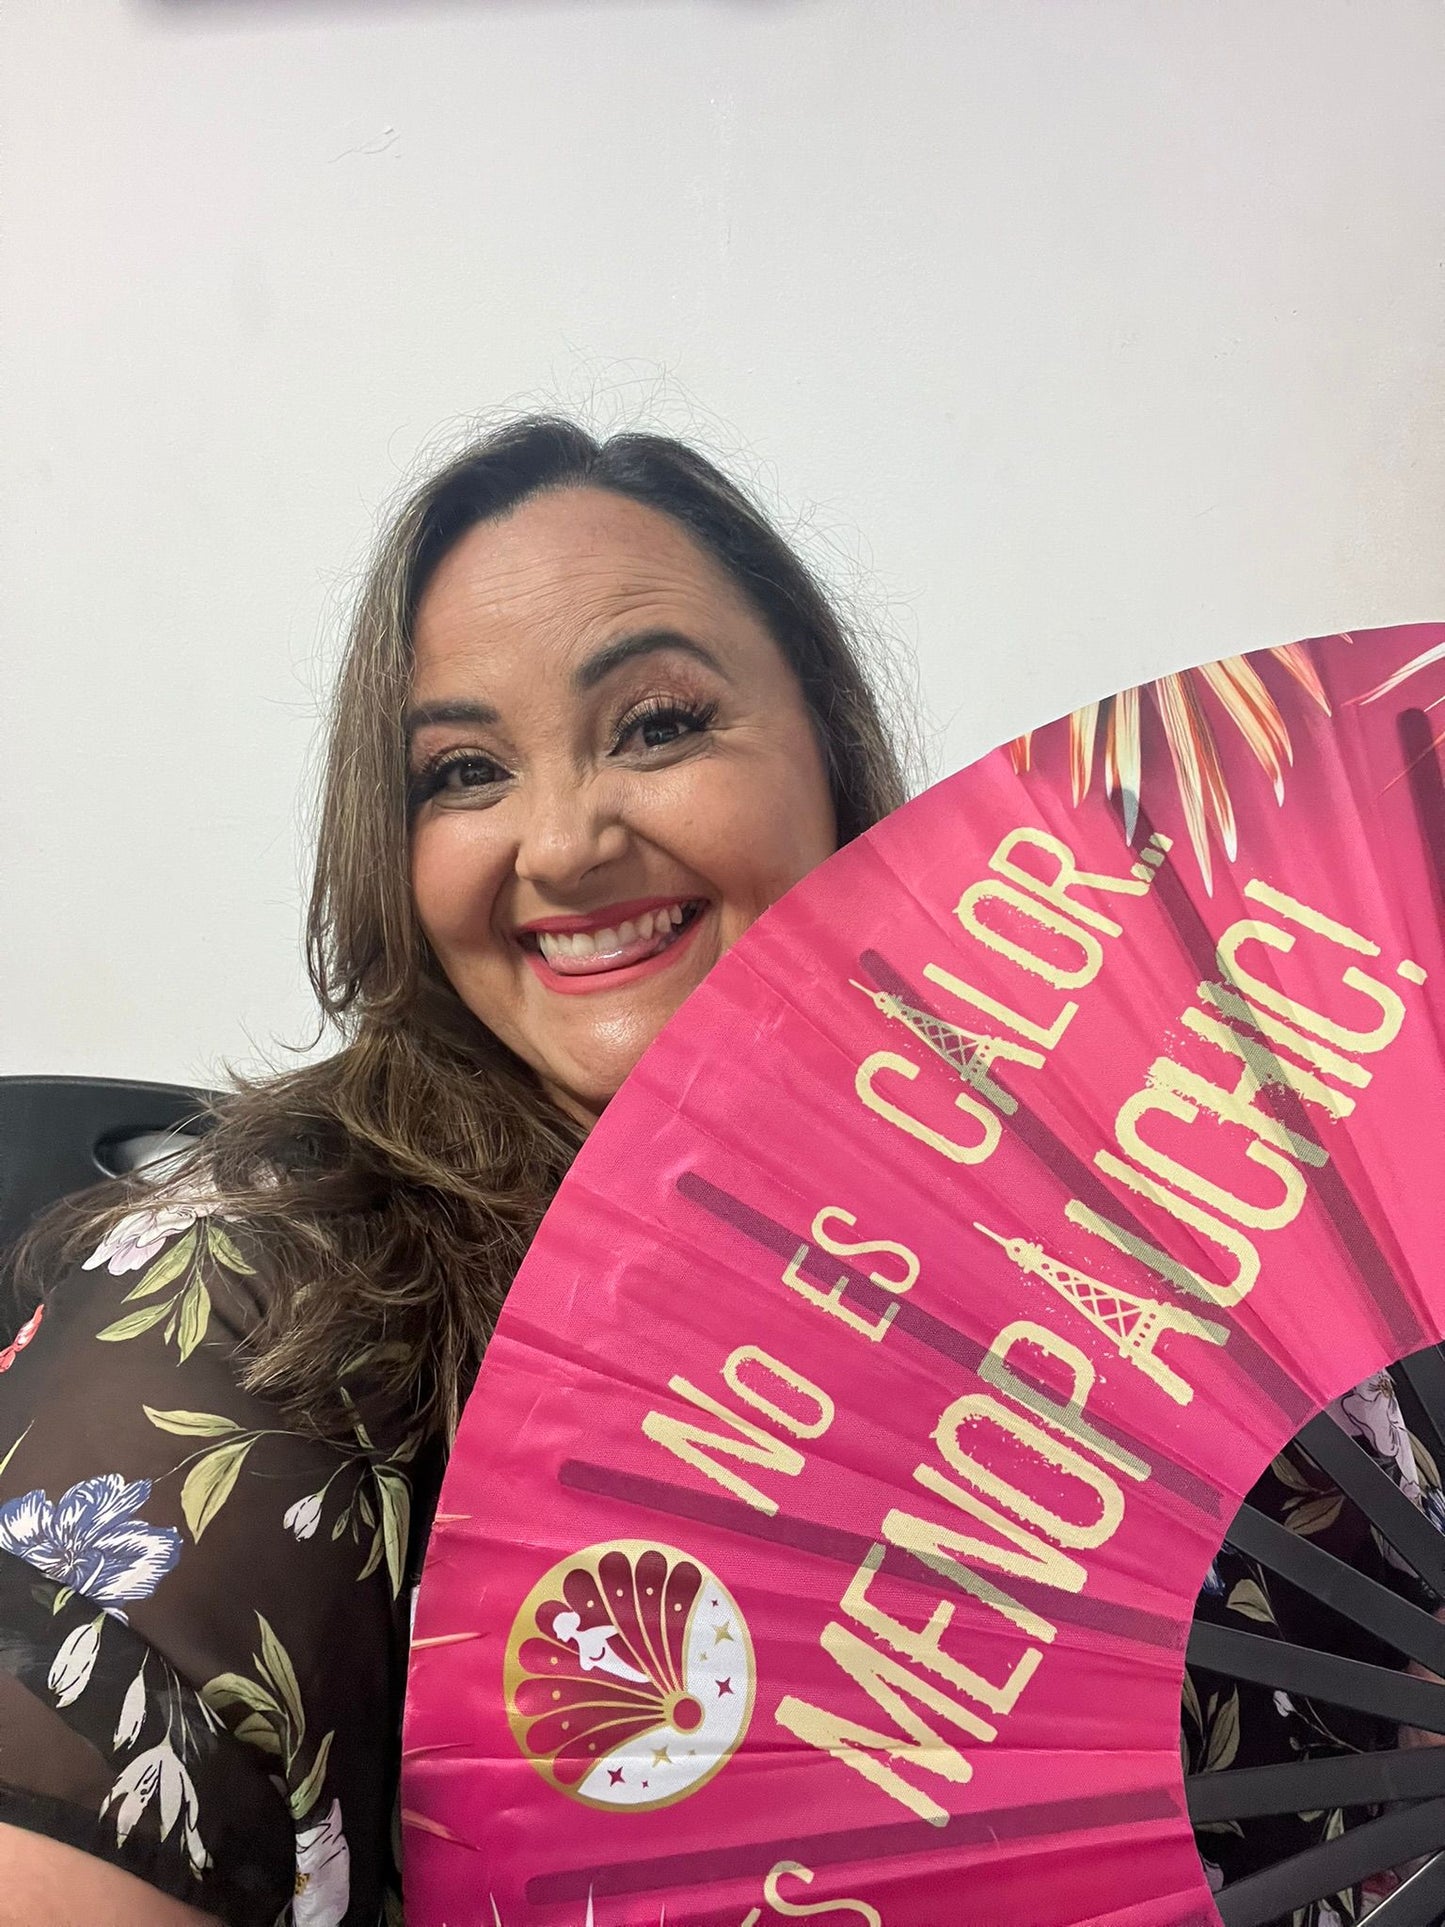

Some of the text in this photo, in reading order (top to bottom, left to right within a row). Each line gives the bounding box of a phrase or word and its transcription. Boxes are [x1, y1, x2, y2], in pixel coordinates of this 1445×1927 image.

[641, 1344, 835, 1516] NO
[781, 1205, 921, 1342] ES
[774, 878, 1428, 1828] MENOPAUCHIC!
